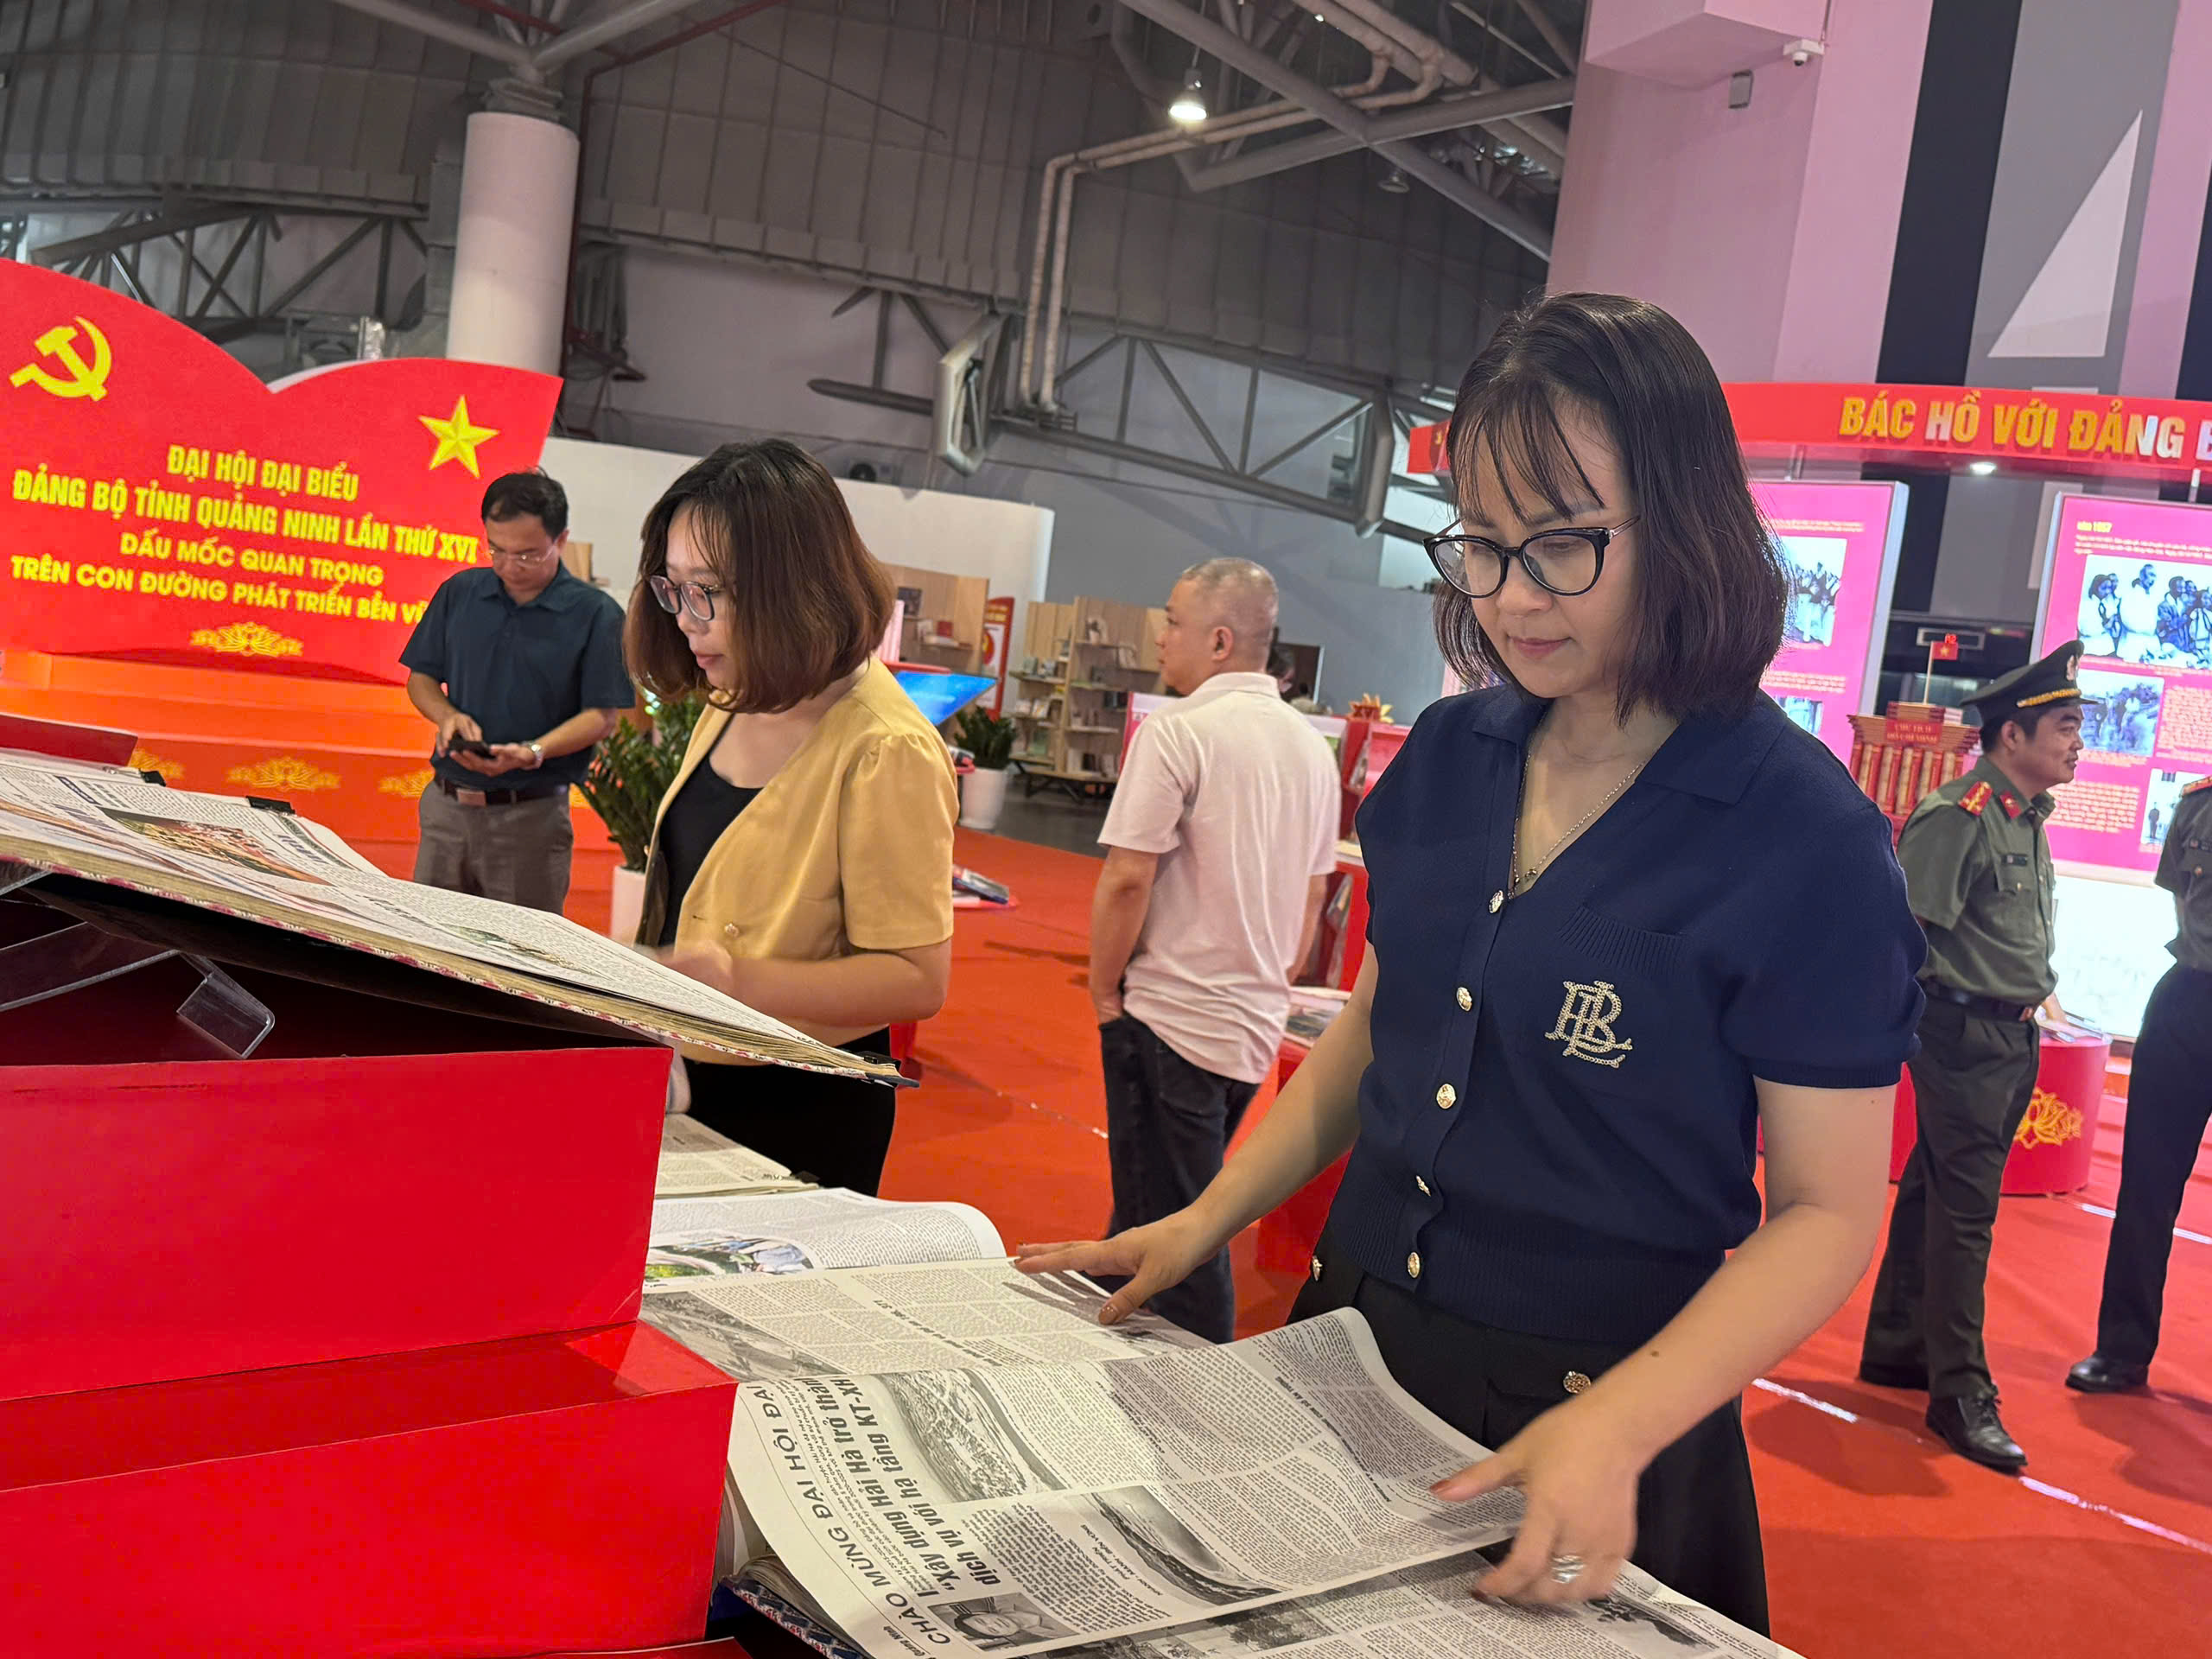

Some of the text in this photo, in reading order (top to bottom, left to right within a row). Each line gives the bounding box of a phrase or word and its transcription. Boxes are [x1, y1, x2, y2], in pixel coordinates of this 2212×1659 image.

[1839, 391, 1916, 439] BÁC
[1924, 390, 1981, 443] HỒ
[1993, 398, 2058, 448] VỚI
[2069, 399, 2184, 459] ĐẢNG
[13, 462, 86, 509] ĐẢNG
[92, 478, 128, 519] BỘ
[135, 479, 191, 523] TỈNH
[196, 492, 277, 536] QUẢNG
[283, 508, 340, 543] NINH
[394, 524, 438, 557] THỨ
[437, 531, 479, 564] XVI
[167, 444, 359, 501] ĐẠI HỘI ĐẠI BIỂU
[11, 552, 70, 584] TRÊN
[76, 563, 134, 591] CON
[139, 569, 227, 601] ĐƯỜNG
[232, 581, 290, 609] PHÁT
[295, 581, 353, 616] TRIỂN
[120, 526, 384, 587] DẤU MỐC QUAN TRỌNG
[747, 1385, 950, 1643] CHÀO MỪNG ĐẠI HỘI ĐẠI
[793, 1378, 961, 1590] “Xây dựng Hải Hà trở thàn
[830, 1379, 1001, 1585] dịch vụ với hạ tầng KT-XH
